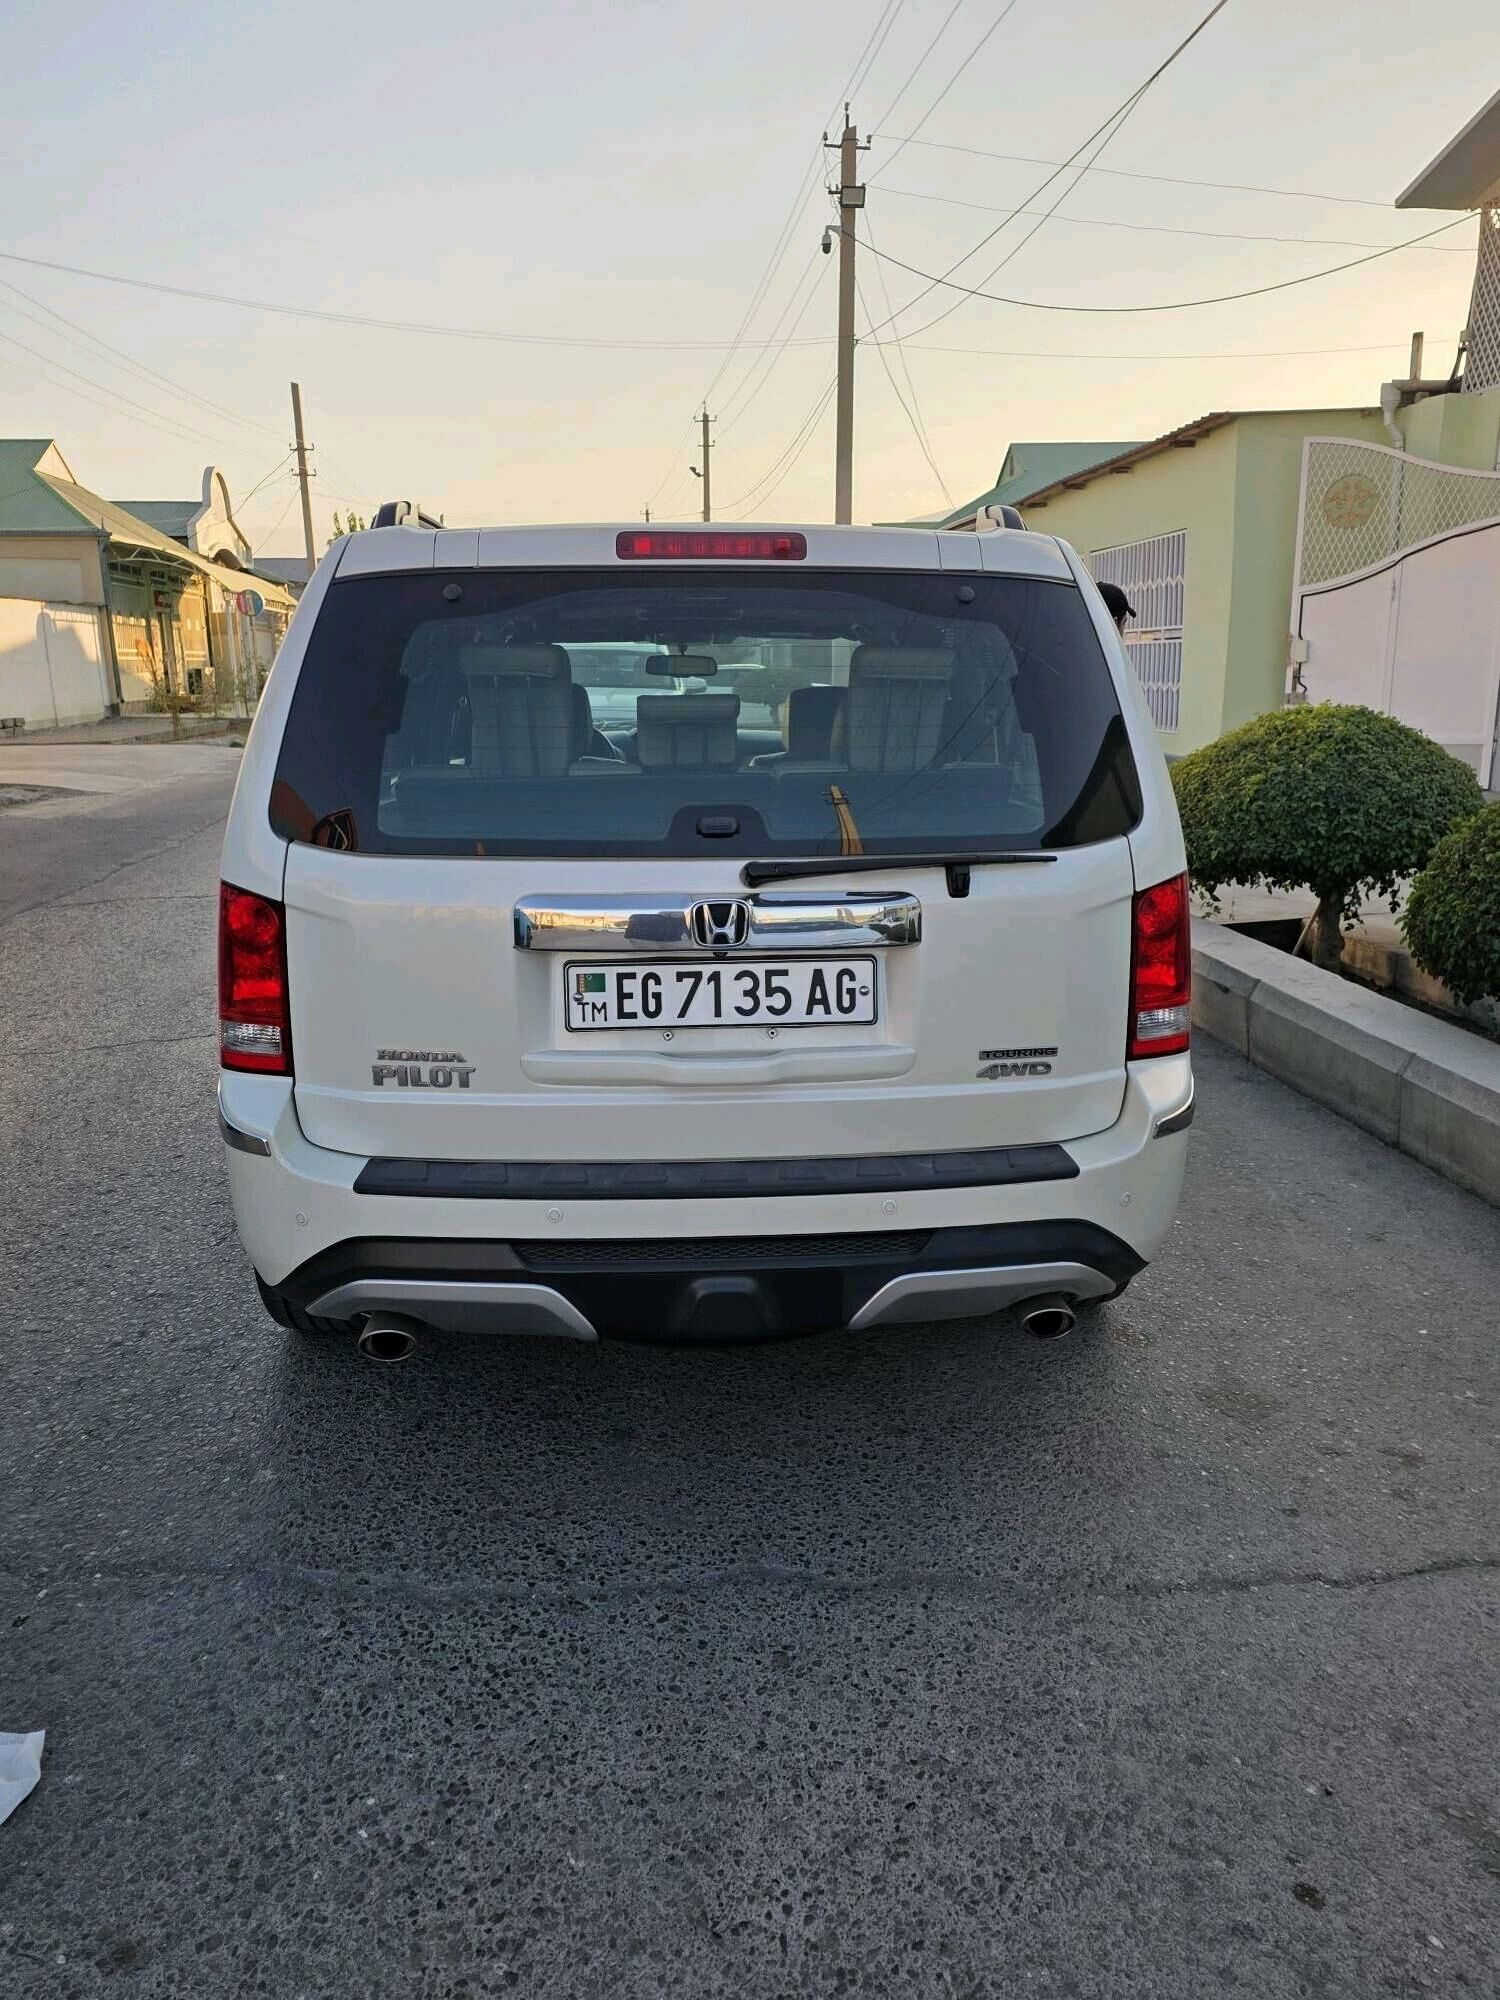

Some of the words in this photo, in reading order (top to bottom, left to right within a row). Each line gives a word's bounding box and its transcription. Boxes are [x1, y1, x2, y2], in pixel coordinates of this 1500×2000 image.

[616, 971, 663, 1019] EG
[675, 969, 793, 1018] 7135
[805, 968, 858, 1015] AG
[577, 1001, 608, 1022] TM
[376, 1049, 467, 1062] HONDA
[981, 1048, 1058, 1059] TOURING
[372, 1065, 476, 1088] PILOT
[976, 1062, 1052, 1080] 4WD
